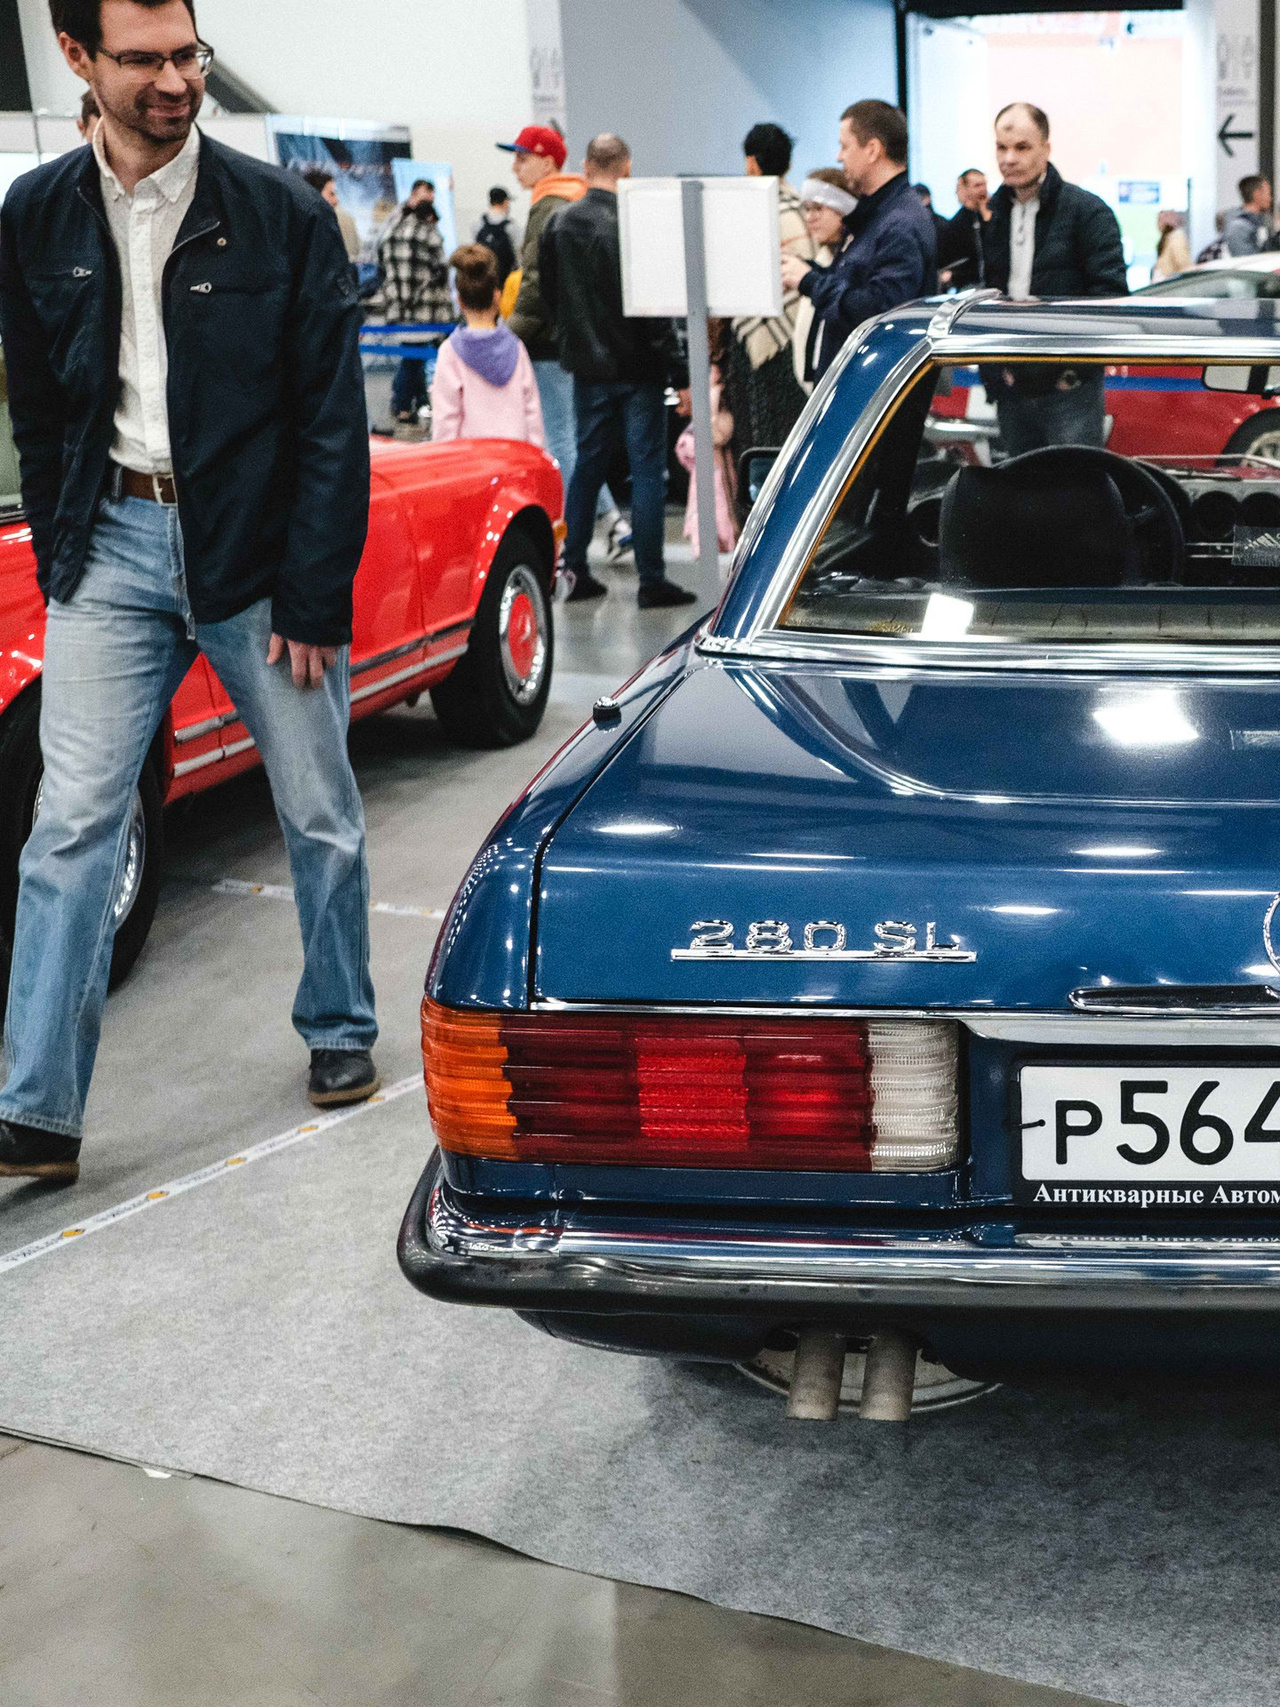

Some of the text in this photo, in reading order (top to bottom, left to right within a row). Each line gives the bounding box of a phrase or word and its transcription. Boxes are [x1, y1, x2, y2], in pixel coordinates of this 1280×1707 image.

[690, 919, 960, 951] 280 SL
[1033, 1183, 1205, 1209] Антикварные
